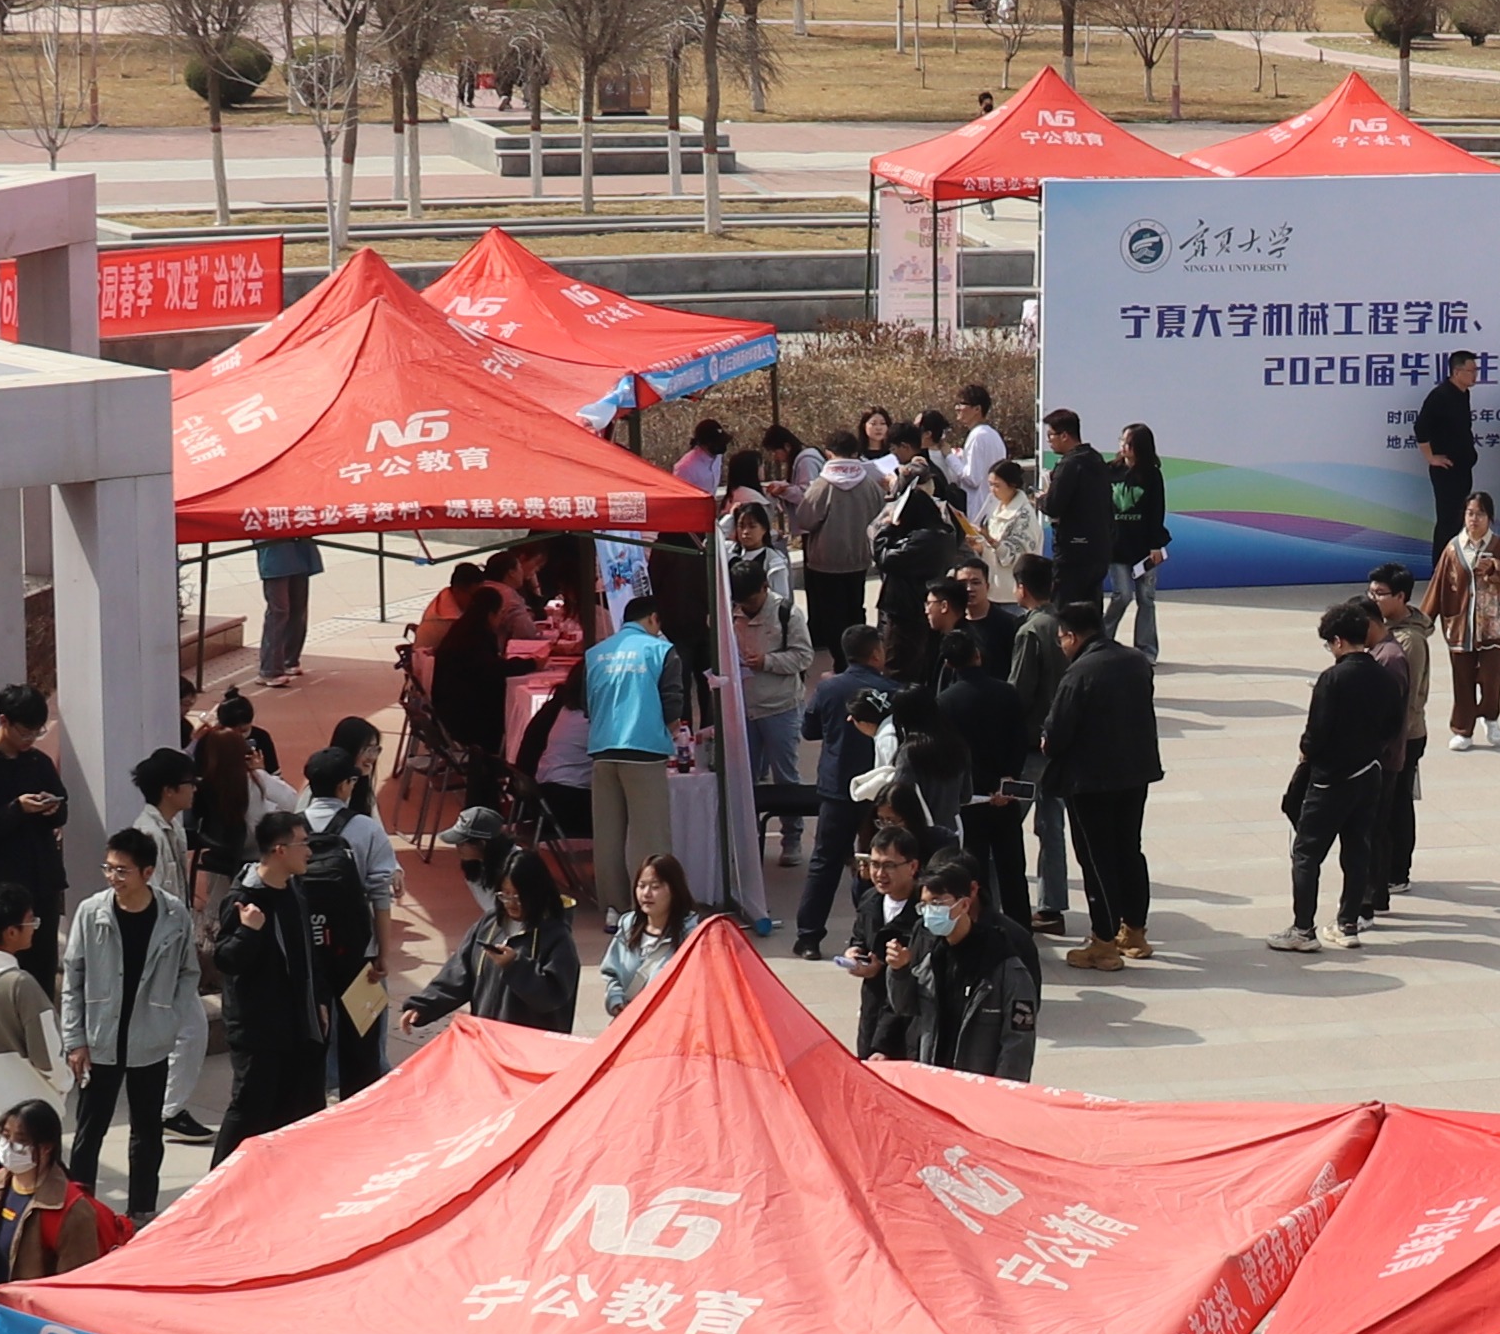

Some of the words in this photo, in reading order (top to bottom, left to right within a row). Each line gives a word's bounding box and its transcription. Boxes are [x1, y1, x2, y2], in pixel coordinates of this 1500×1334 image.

[1038, 110, 1075, 127] NG
[1350, 117, 1388, 132] NG
[1179, 218, 1294, 263] 宁夏大学
[98, 252, 264, 320] 园春季“双选”洽谈会
[1183, 264, 1227, 273] NINGXIA
[1229, 263, 1288, 273] UNIVERSITY
[366, 409, 450, 452] NG
[339, 447, 491, 485] 宁公教育
[543, 1184, 741, 1263] NG
